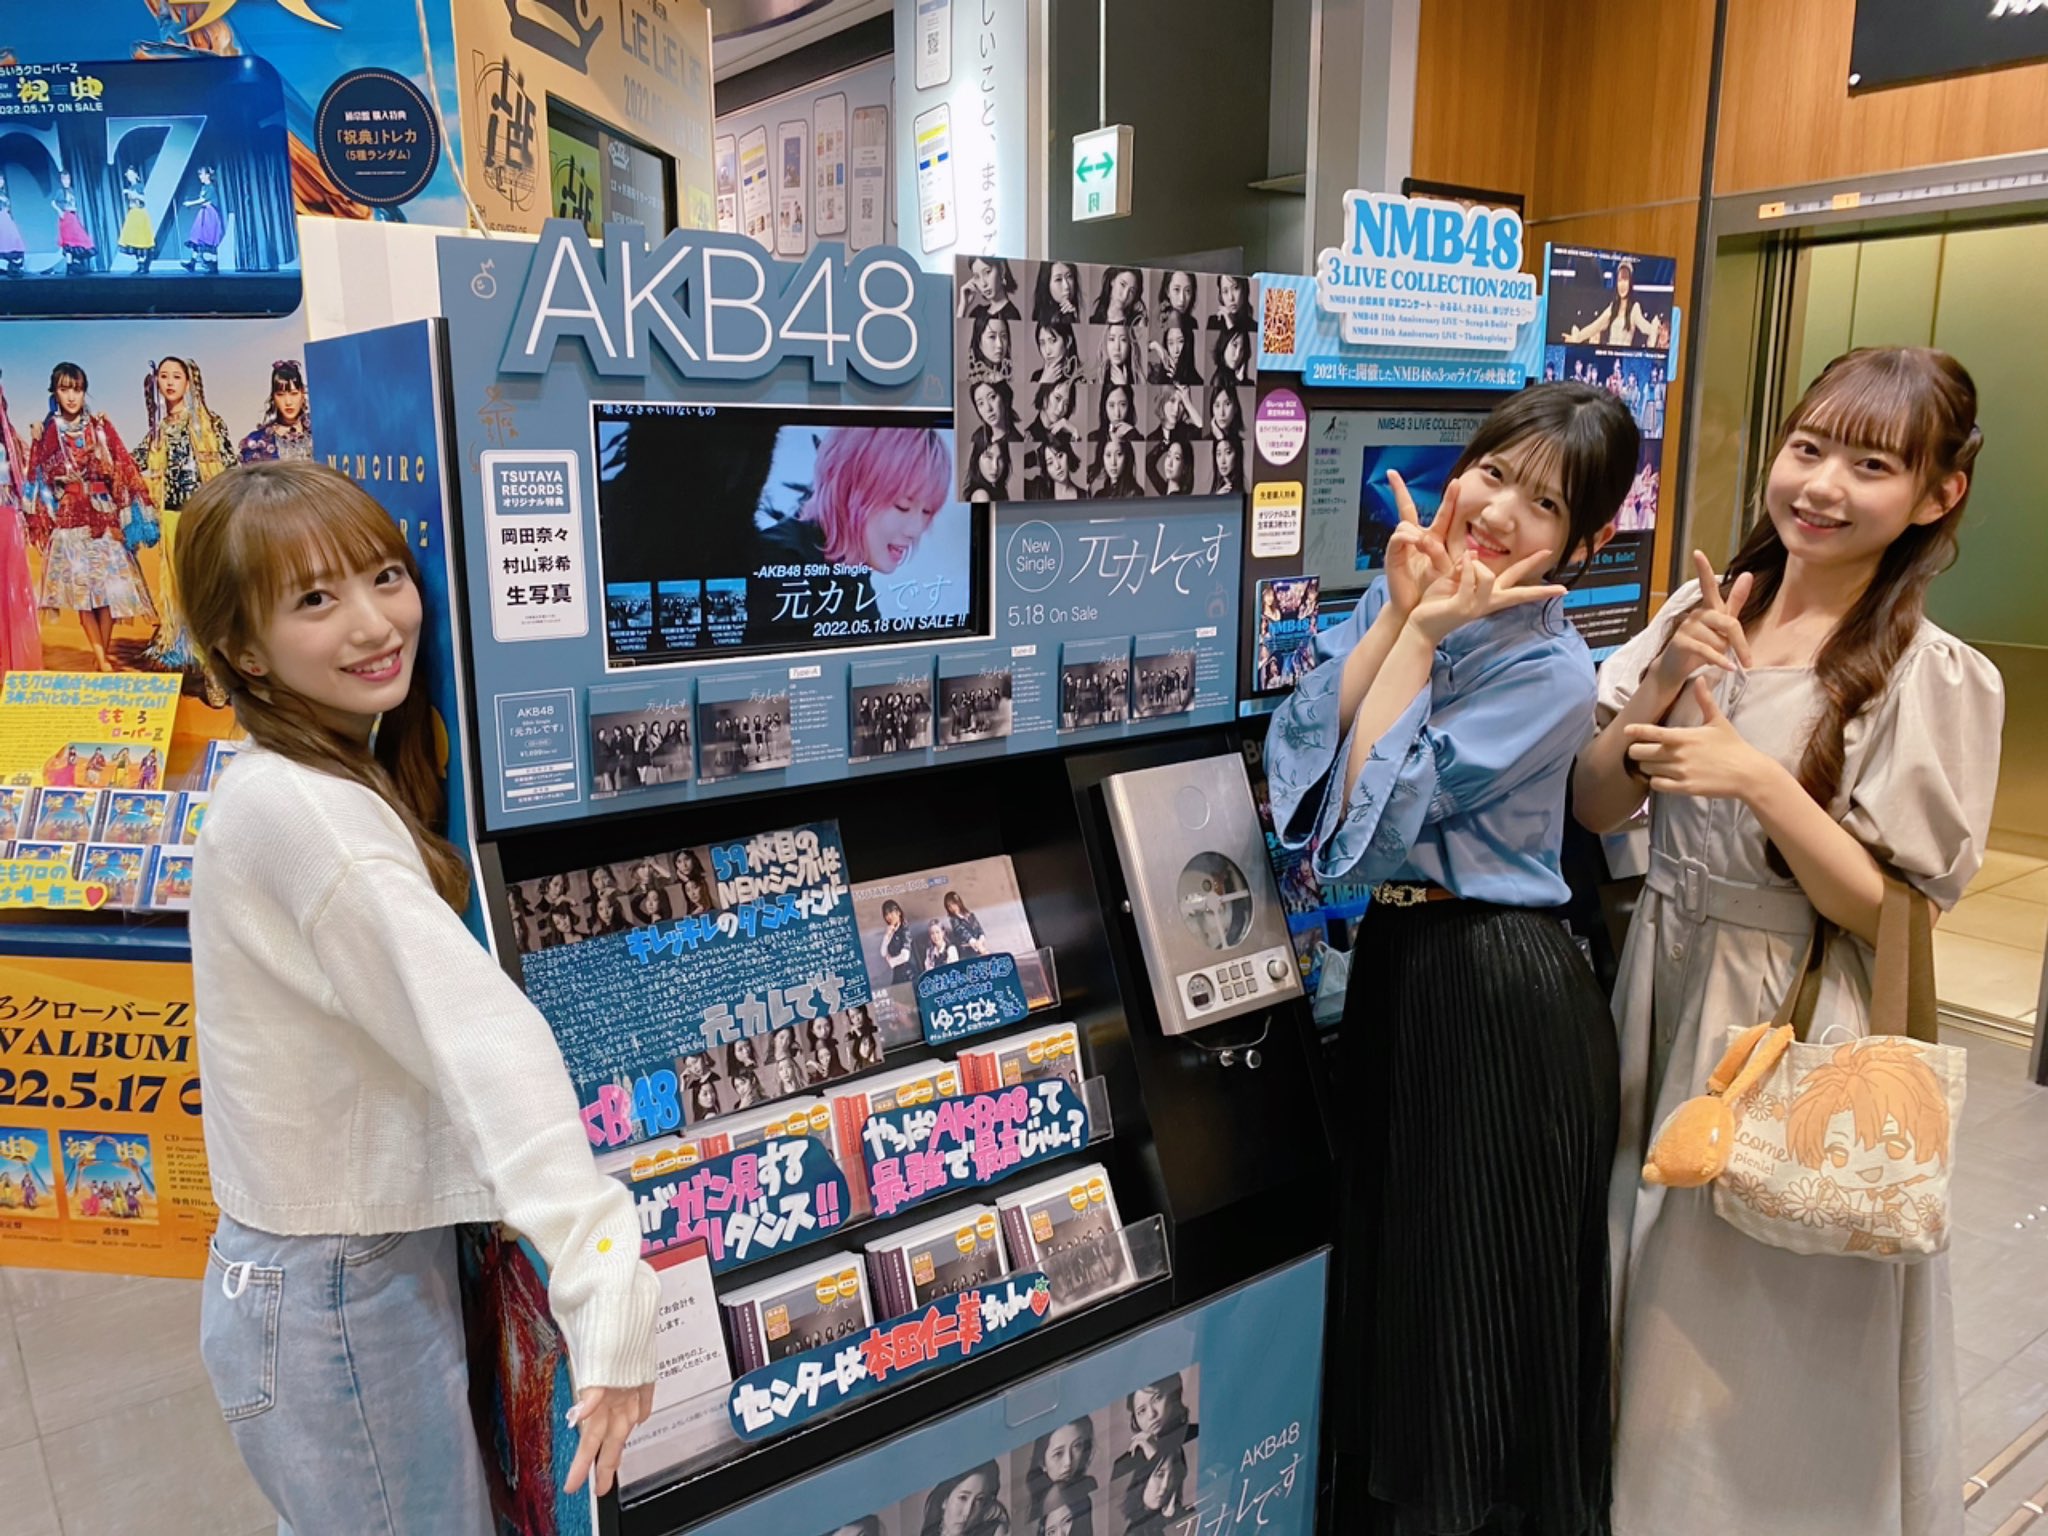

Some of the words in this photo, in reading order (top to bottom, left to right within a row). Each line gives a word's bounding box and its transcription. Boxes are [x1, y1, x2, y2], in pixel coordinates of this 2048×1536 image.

[57, 103, 73, 112] ON
[75, 102, 103, 112] SALE
[1352, 198, 1519, 270] NMB48
[1343, 265, 1387, 289] LIVE
[1391, 270, 1500, 296] COLLECTION
[524, 236, 919, 370] AKB48
[1377, 417, 1407, 430] NMB48
[1414, 418, 1431, 430] LIVE
[327, 454, 425, 483] MOMOIRO
[500, 470, 563, 483] TSUTAYA
[501, 484, 564, 496] RECORDS
[502, 497, 565, 507] オリジナル特典
[501, 527, 569, 545] 岡田奈々
[1022, 538, 1050, 553] New
[502, 555, 571, 574] 村山彩希
[1016, 556, 1056, 574] Single
[1069, 517, 1232, 597] 元カレです
[803, 563, 830, 577] 59th
[506, 583, 572, 606] 生写真
[771, 574, 951, 622] 元カレです
[812, 618, 890, 637] 2022.05.18
[892, 617, 915, 632] ON
[917, 614, 954, 629] SALE
[1008, 603, 1044, 627] 5.18
[1049, 607, 1067, 623] On
[1071, 606, 1098, 621] Sale
[516, 705, 554, 718] AKB48
[699, 970, 844, 1048] 元カレです
[23, 1028, 192, 1062] ALBUM
[1239, 1421, 1300, 1473] AKB48
